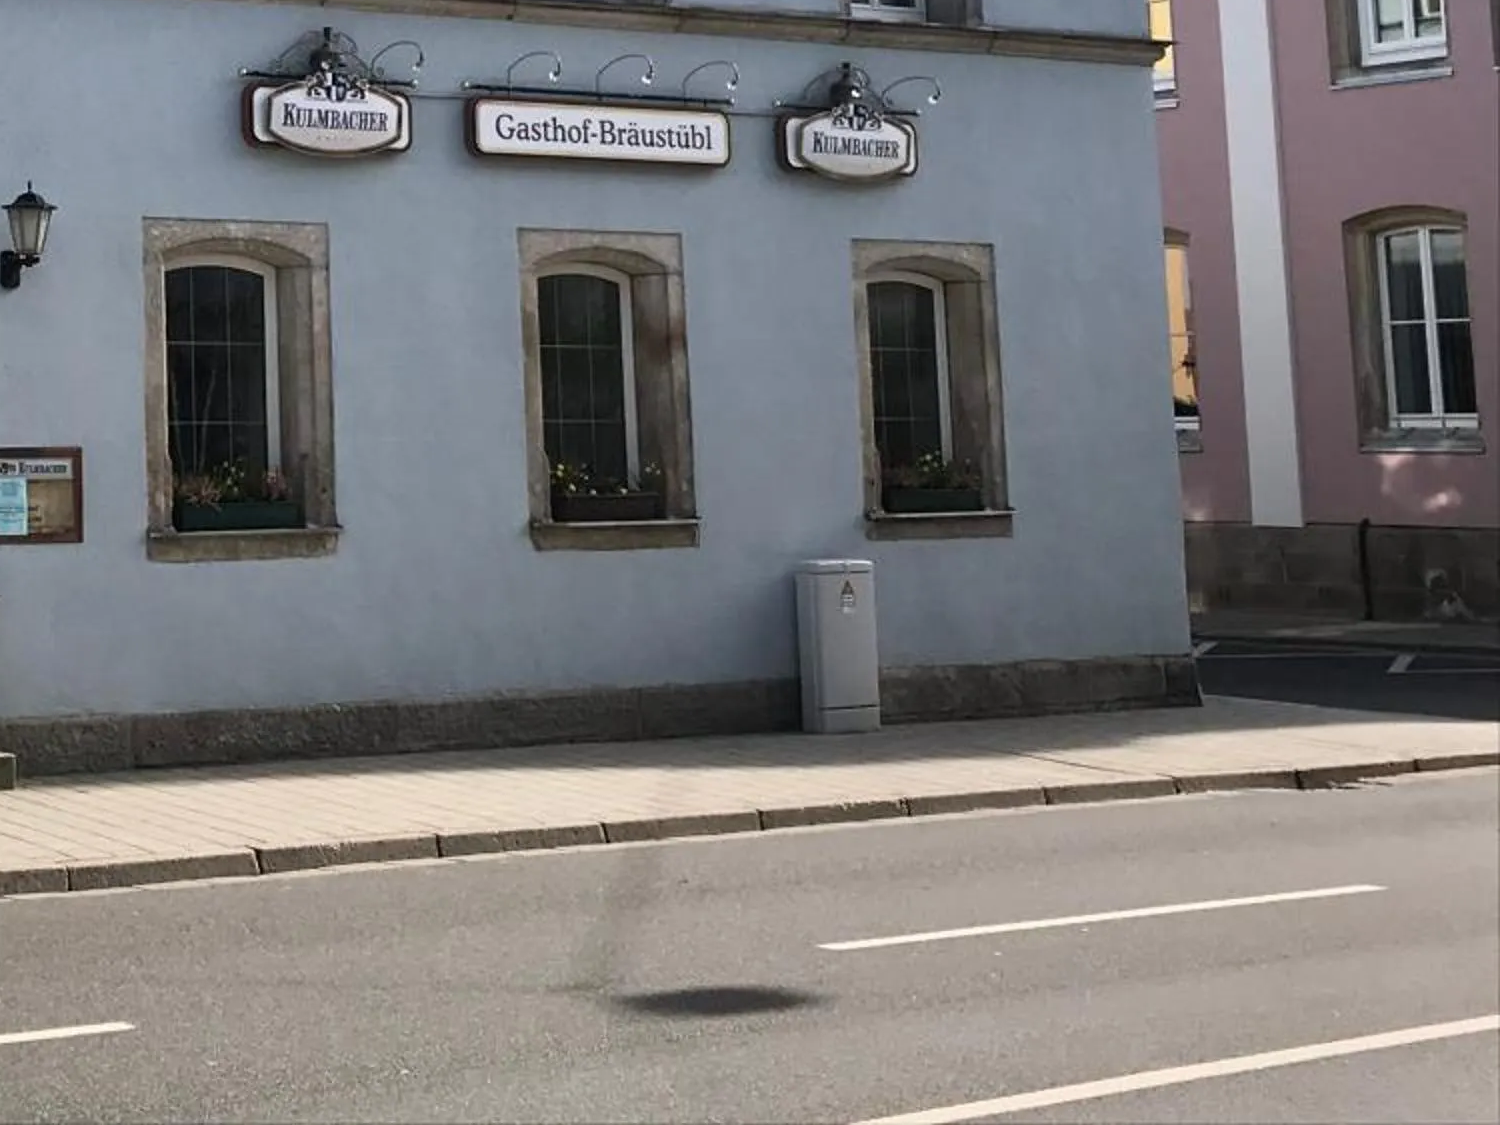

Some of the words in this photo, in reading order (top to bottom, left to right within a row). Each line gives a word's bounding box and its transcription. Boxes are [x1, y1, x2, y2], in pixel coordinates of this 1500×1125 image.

[282, 102, 389, 132] KULMBACHER
[494, 113, 713, 151] Gasthof-Bräustübl
[812, 130, 900, 159] KULMBACHER
